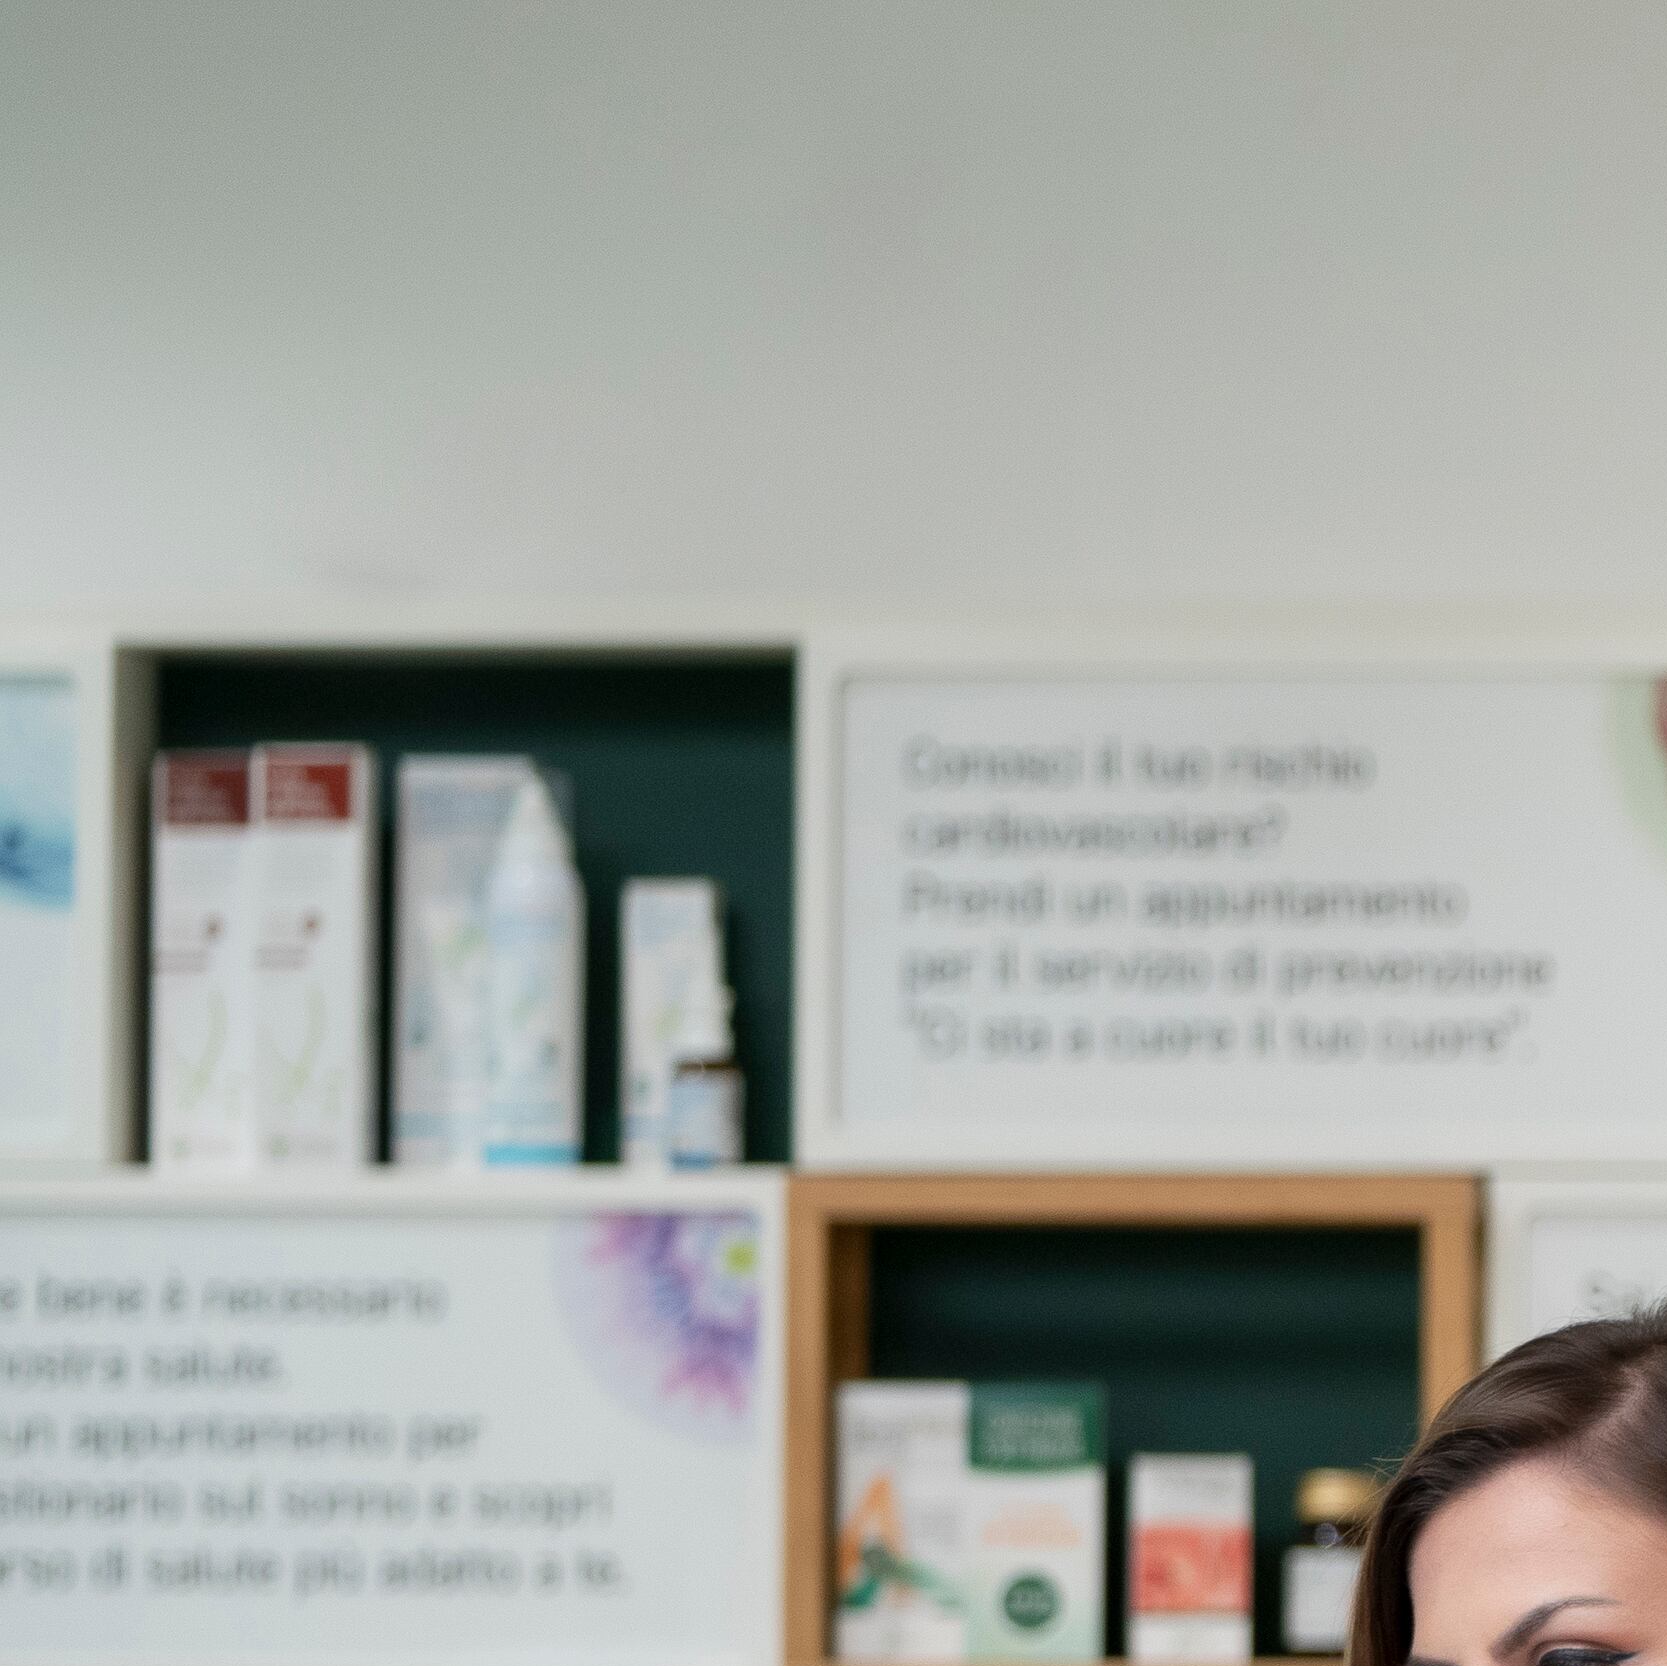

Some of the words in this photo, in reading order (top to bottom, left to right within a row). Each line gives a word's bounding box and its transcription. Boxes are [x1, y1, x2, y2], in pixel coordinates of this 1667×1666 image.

[902, 735, 1082, 790] Conosci
[1098, 735, 1122, 790] il
[1138, 735, 1209, 790] tuo
[1224, 735, 1375, 790] rischio
[902, 803, 1287, 857] cardiovascolare?
[902, 870, 1050, 922] Prendi
[1068, 880, 1126, 922] un
[1142, 876, 1467, 928] appuntamento
[901, 950, 973, 1003] per
[1037, 942, 1211, 994] servizio
[1225, 942, 1261, 994] di
[1278, 946, 1556, 1001] prevenzione
[981, 1010, 1048, 1061] sta
[1106, 1020, 1232, 1061] cuore
[1290, 1010, 1366, 1061] tuo
[203, 1276, 450, 1321] necessario
[70, 1412, 395, 1463] appuntamento
[408, 1416, 483, 1464] per
[144, 1545, 281, 1592] salute
